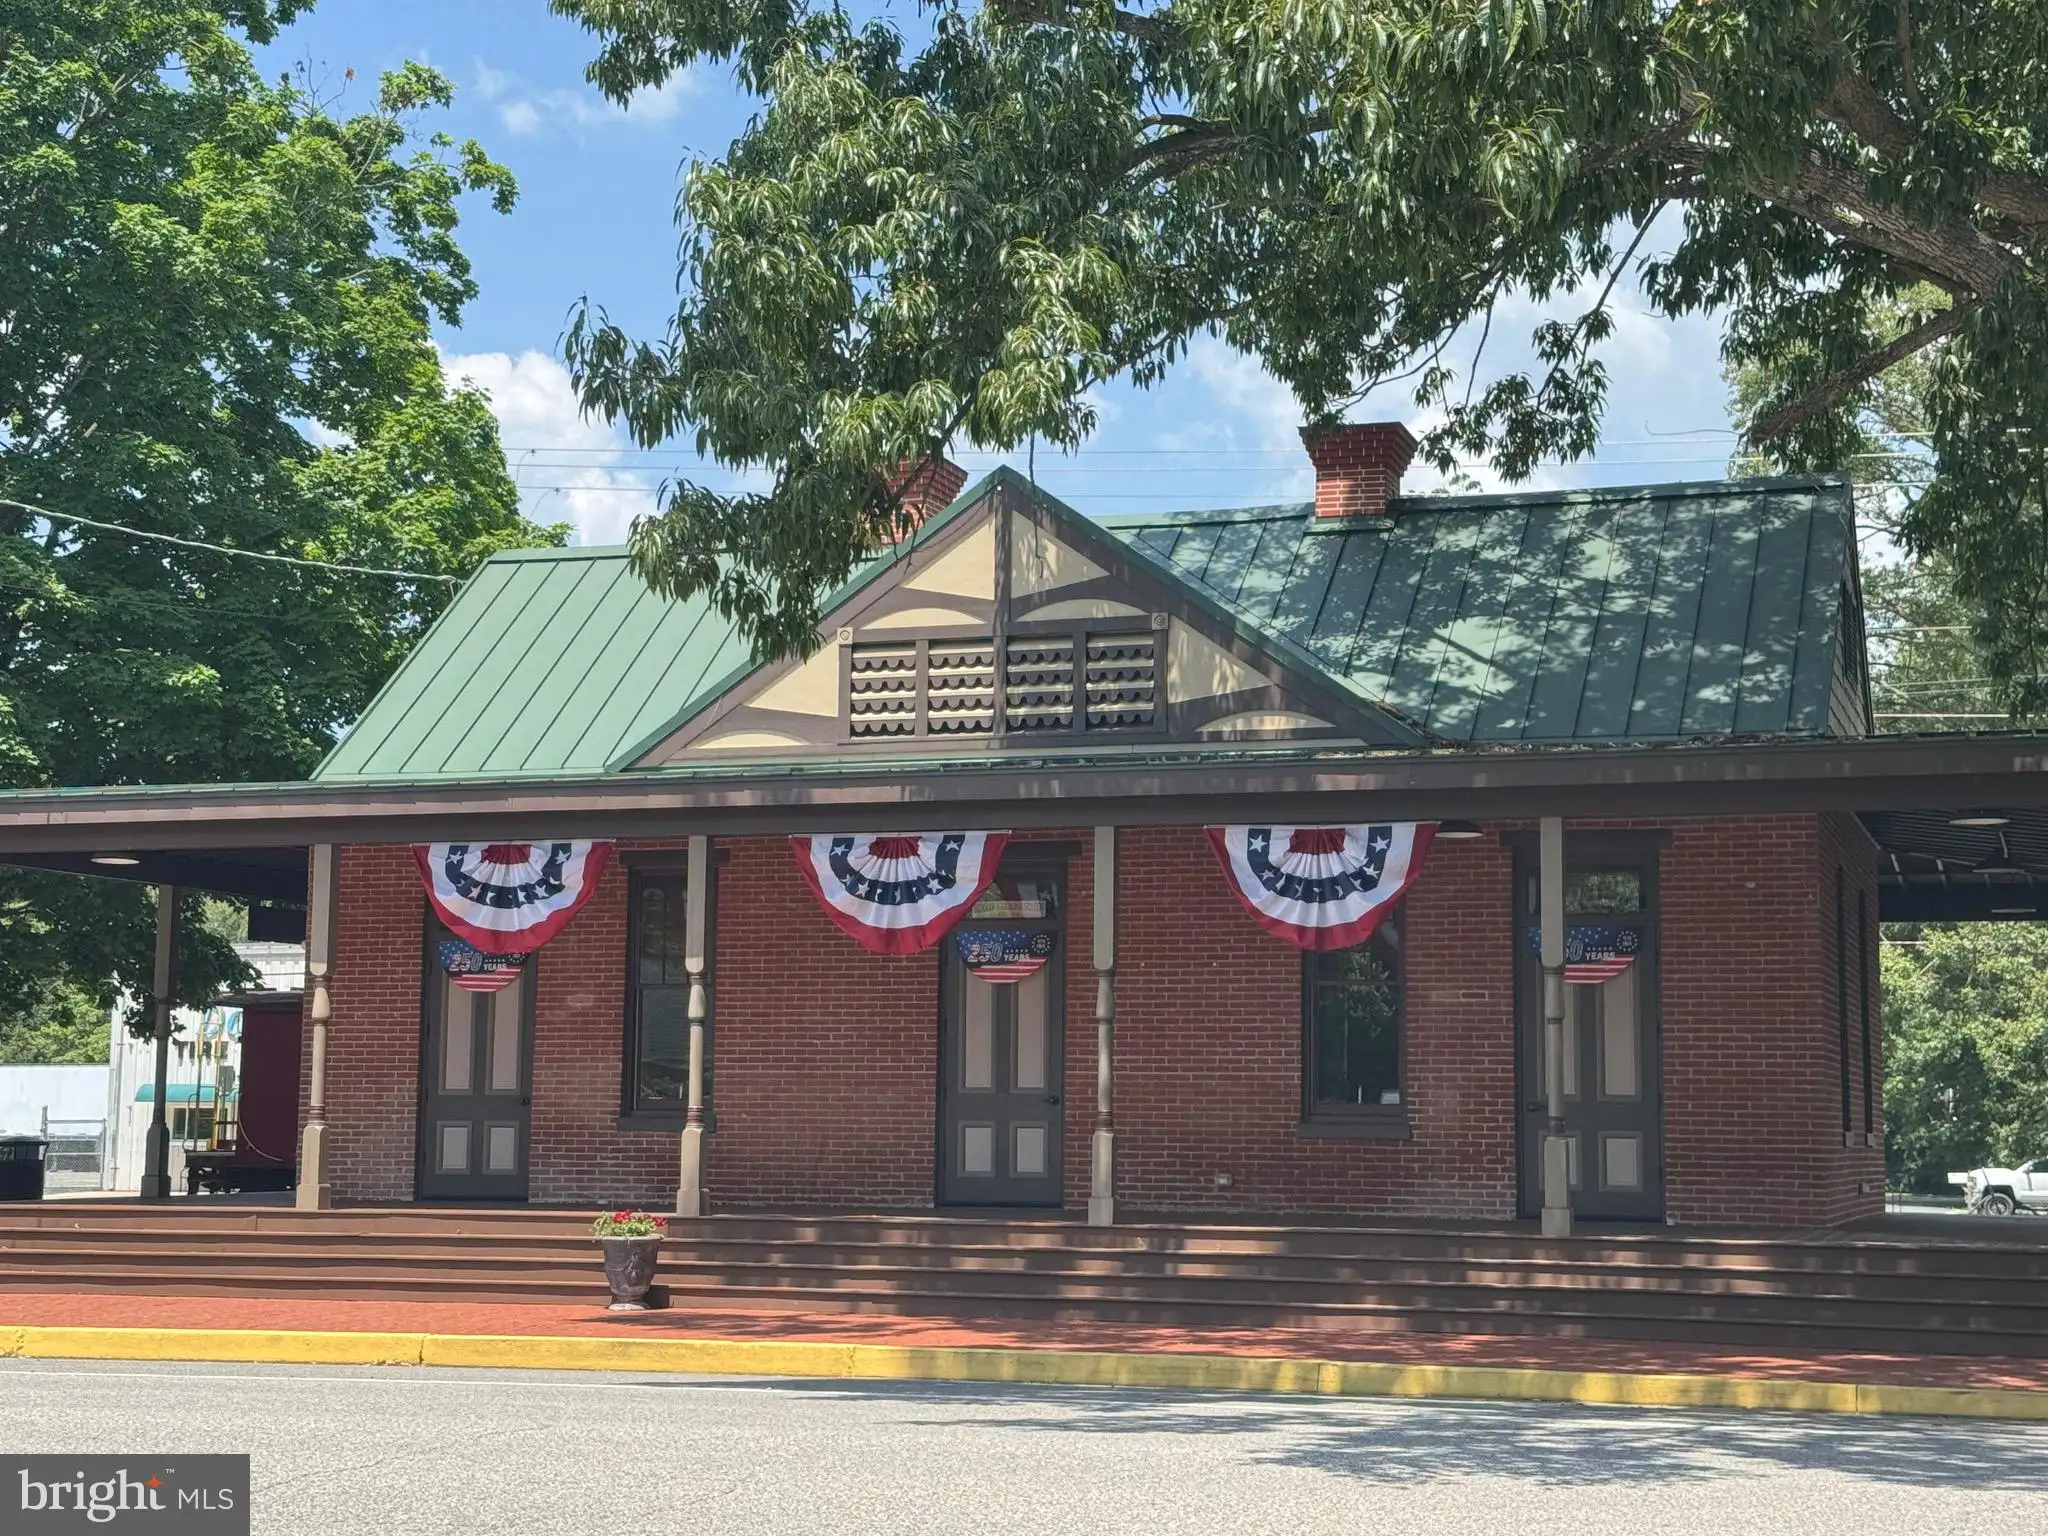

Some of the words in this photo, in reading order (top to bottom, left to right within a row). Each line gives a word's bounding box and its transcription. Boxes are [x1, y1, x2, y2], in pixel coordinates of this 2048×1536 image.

[967, 943, 1003, 962] 250
[1003, 953, 1030, 961] YEARS
[1585, 952, 1616, 960] YEARS
[449, 953, 483, 971] 250
[483, 963, 507, 971] YEARS
